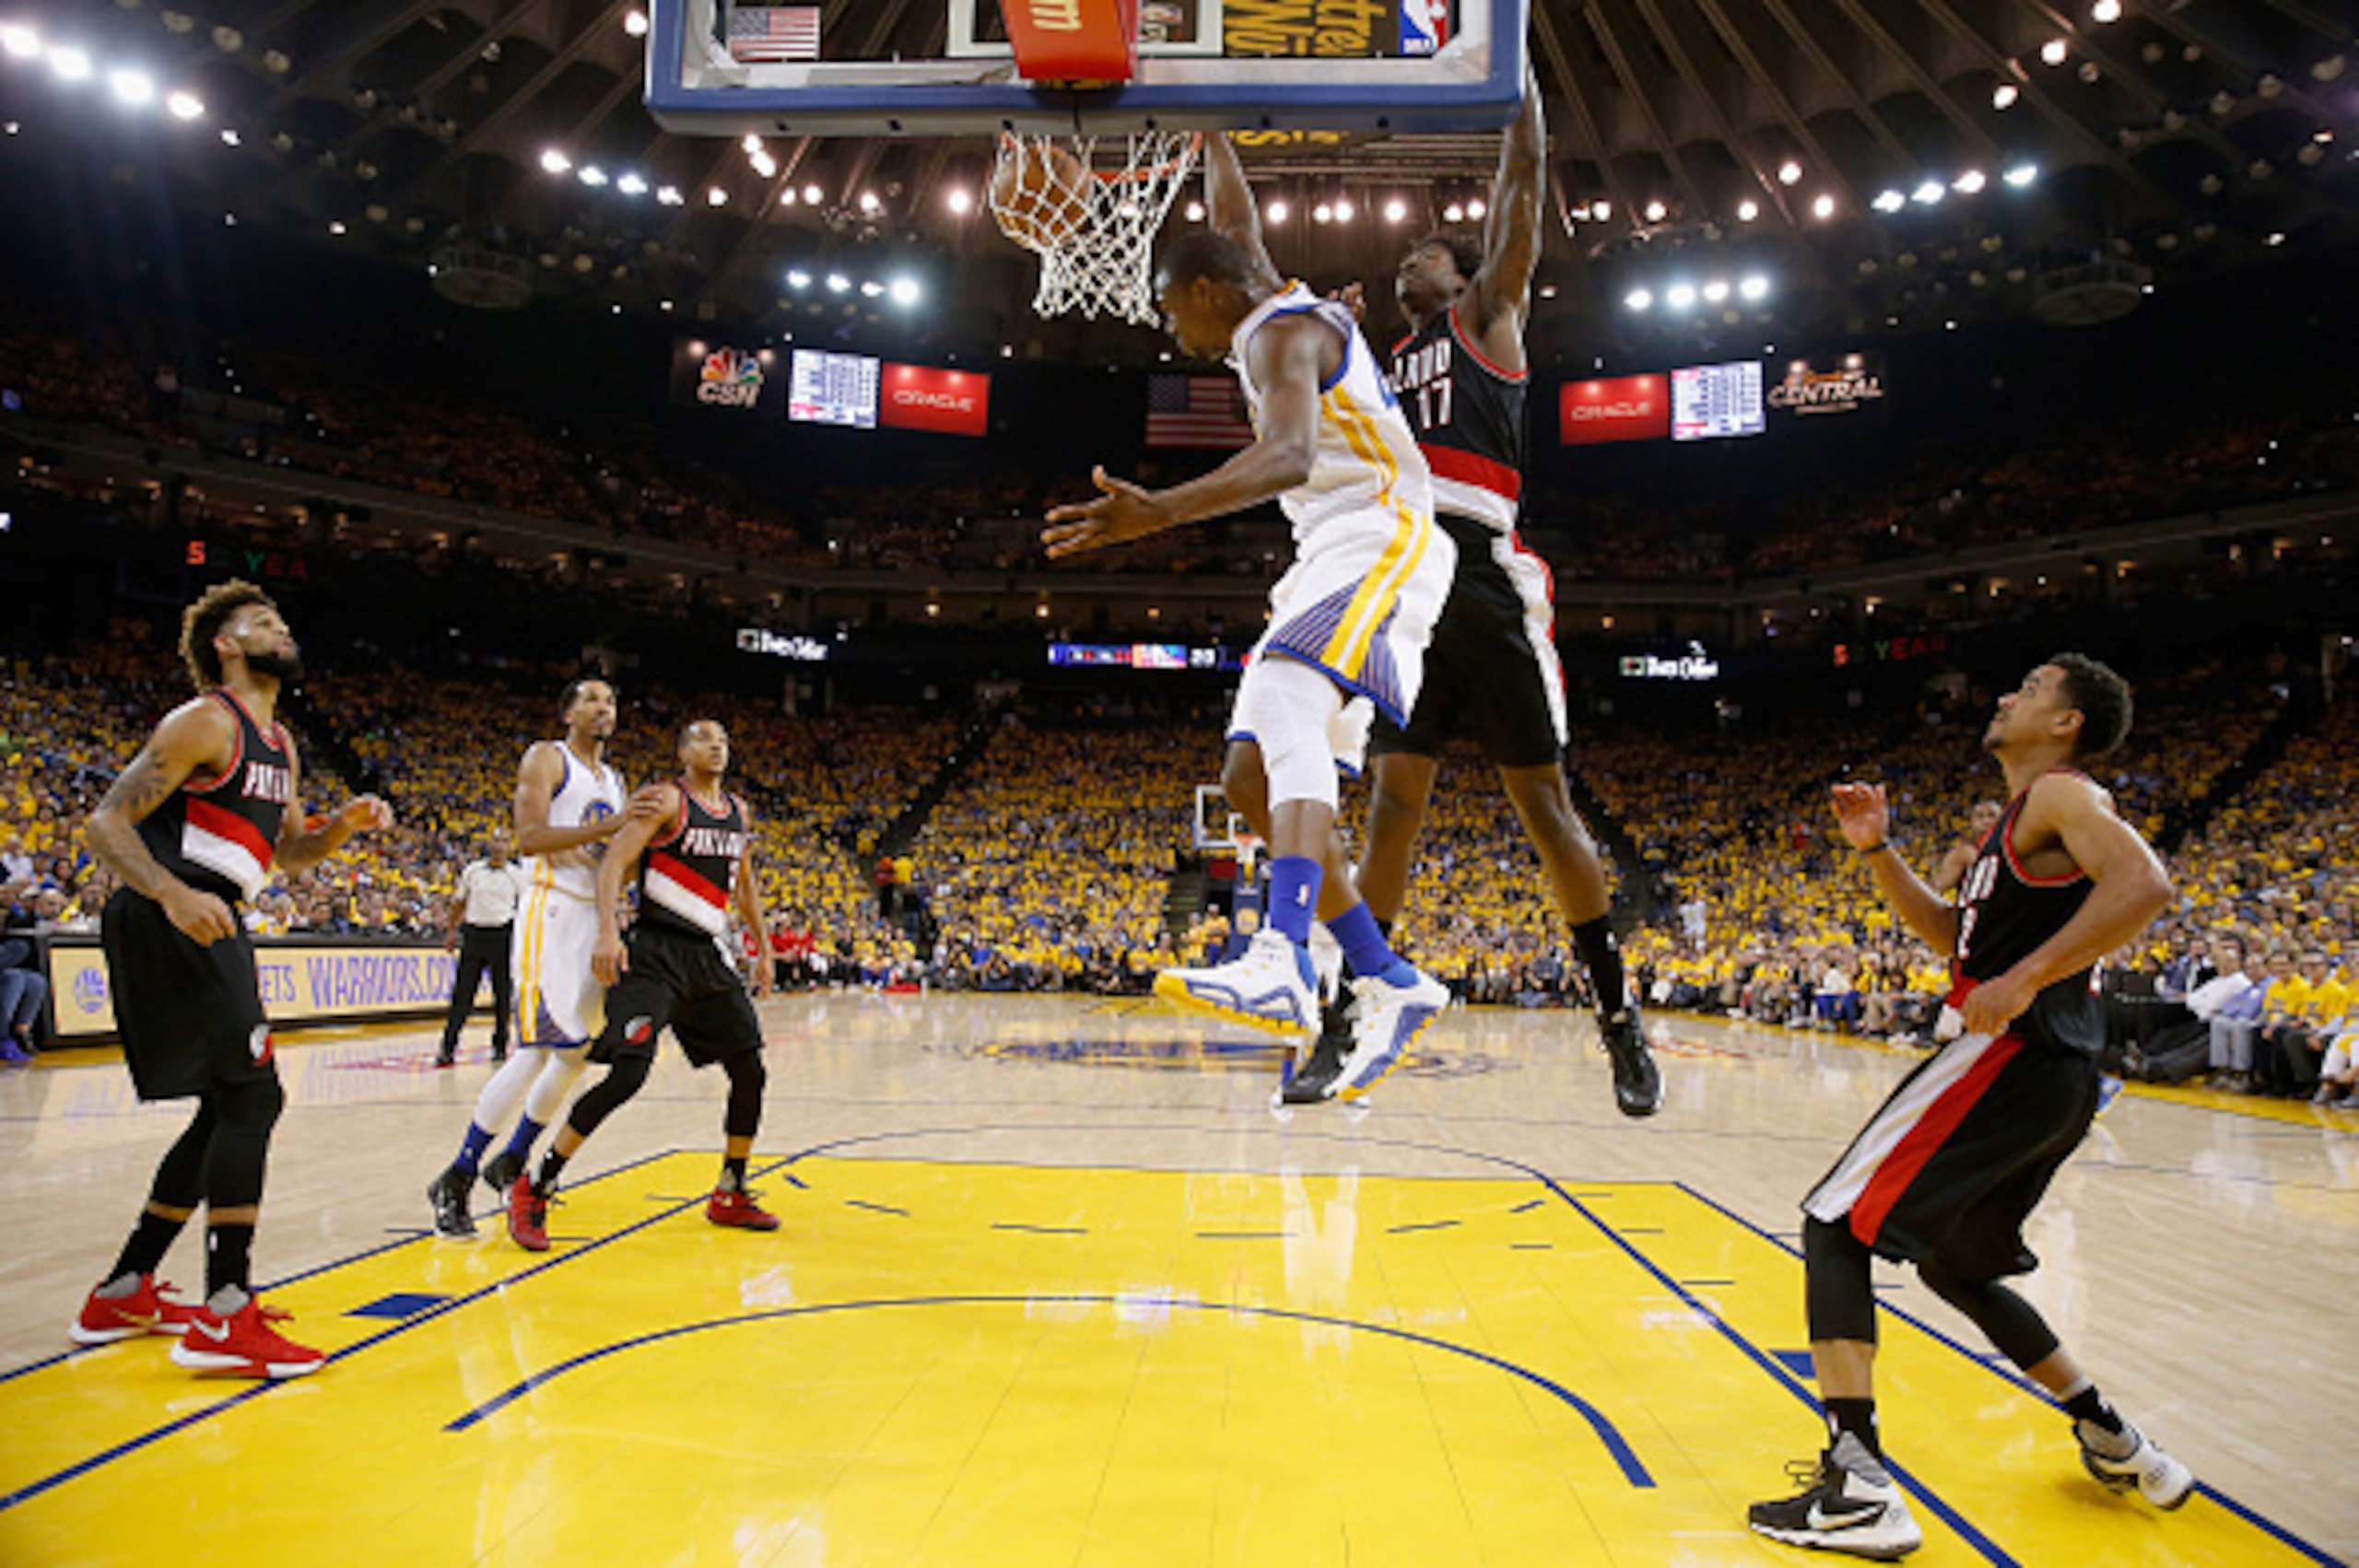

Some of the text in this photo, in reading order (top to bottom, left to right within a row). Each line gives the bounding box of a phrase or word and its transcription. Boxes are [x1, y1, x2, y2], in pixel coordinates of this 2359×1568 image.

[892, 389, 975, 413] ORACLE
[1416, 377, 1452, 430] 17
[1767, 377, 1885, 407] CENTRAL
